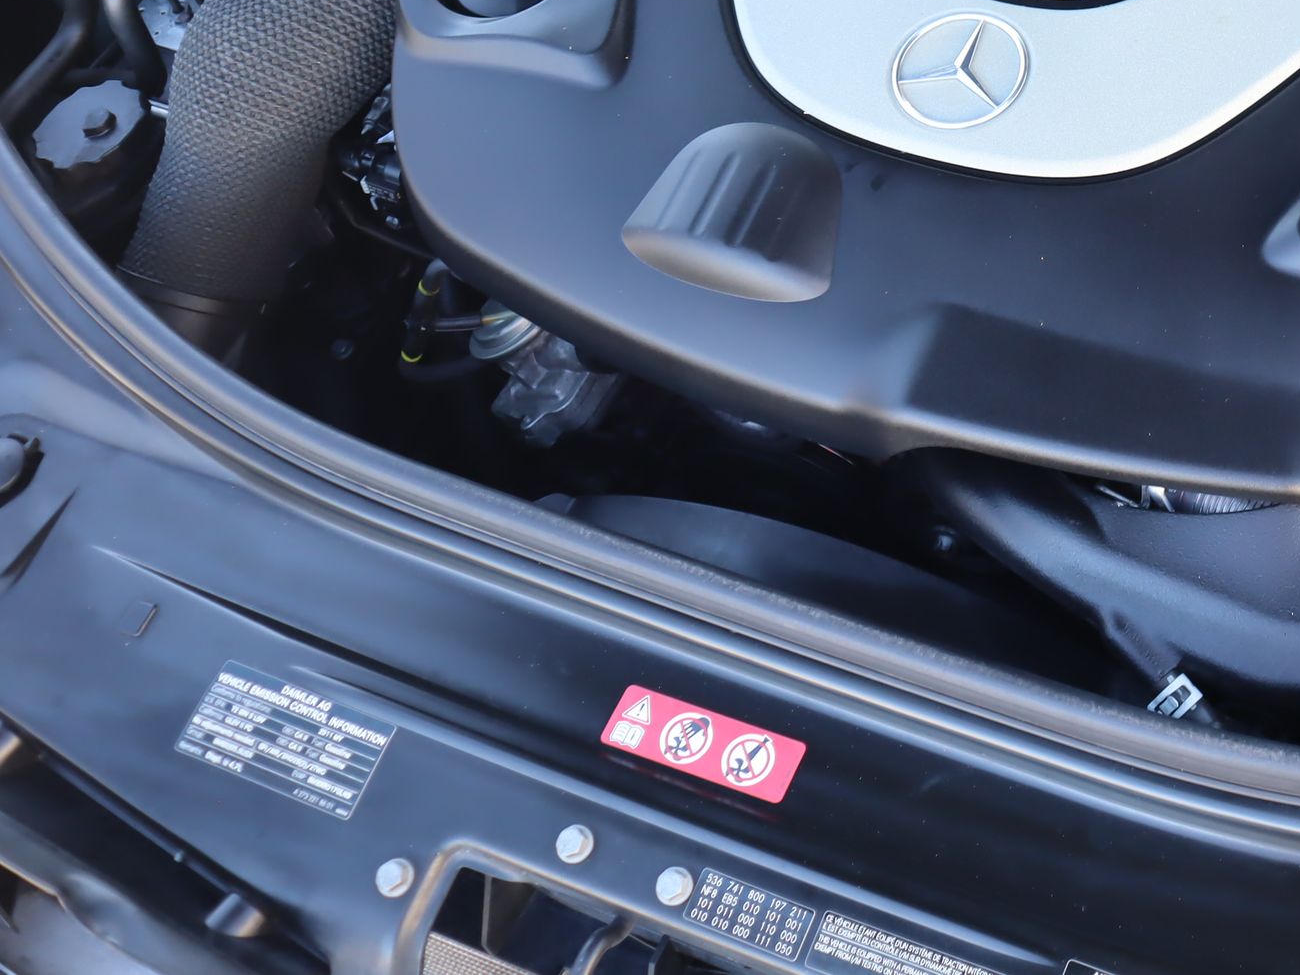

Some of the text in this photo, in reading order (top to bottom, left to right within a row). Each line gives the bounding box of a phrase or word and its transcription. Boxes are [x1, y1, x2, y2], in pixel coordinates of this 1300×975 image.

[218, 672, 252, 692] VEHICLE
[250, 685, 291, 707] EMISSION
[290, 701, 330, 723] CONTROL
[329, 716, 387, 746] INFORMATION
[281, 686, 318, 706] DAIMLER
[317, 700, 332, 712] AG
[701, 884, 802, 932] NF8 EB5 010 101 001
[706, 873, 807, 920] 536 741 800 197 211
[690, 908, 792, 956] 010 010 000 111 050
[697, 897, 797, 944] 101 011 000 110 000
[814, 942, 835, 955] EXEMPT
[835, 950, 851, 961] FROM
[862, 960, 883, 973] TESTING
[818, 934, 830, 944] THIS
[830, 939, 851, 951] VEHICLE
[857, 948, 883, 963] EQUIPPED
[882, 958, 897, 968] WITH
[827, 924, 838, 933] EST
[862, 937, 871, 945] DU
[870, 940, 898, 955] CONTRÔLE
[909, 954, 921, 963] SUR
[933, 953, 942, 962] DE
[942, 957, 968, 971] TRACTION
